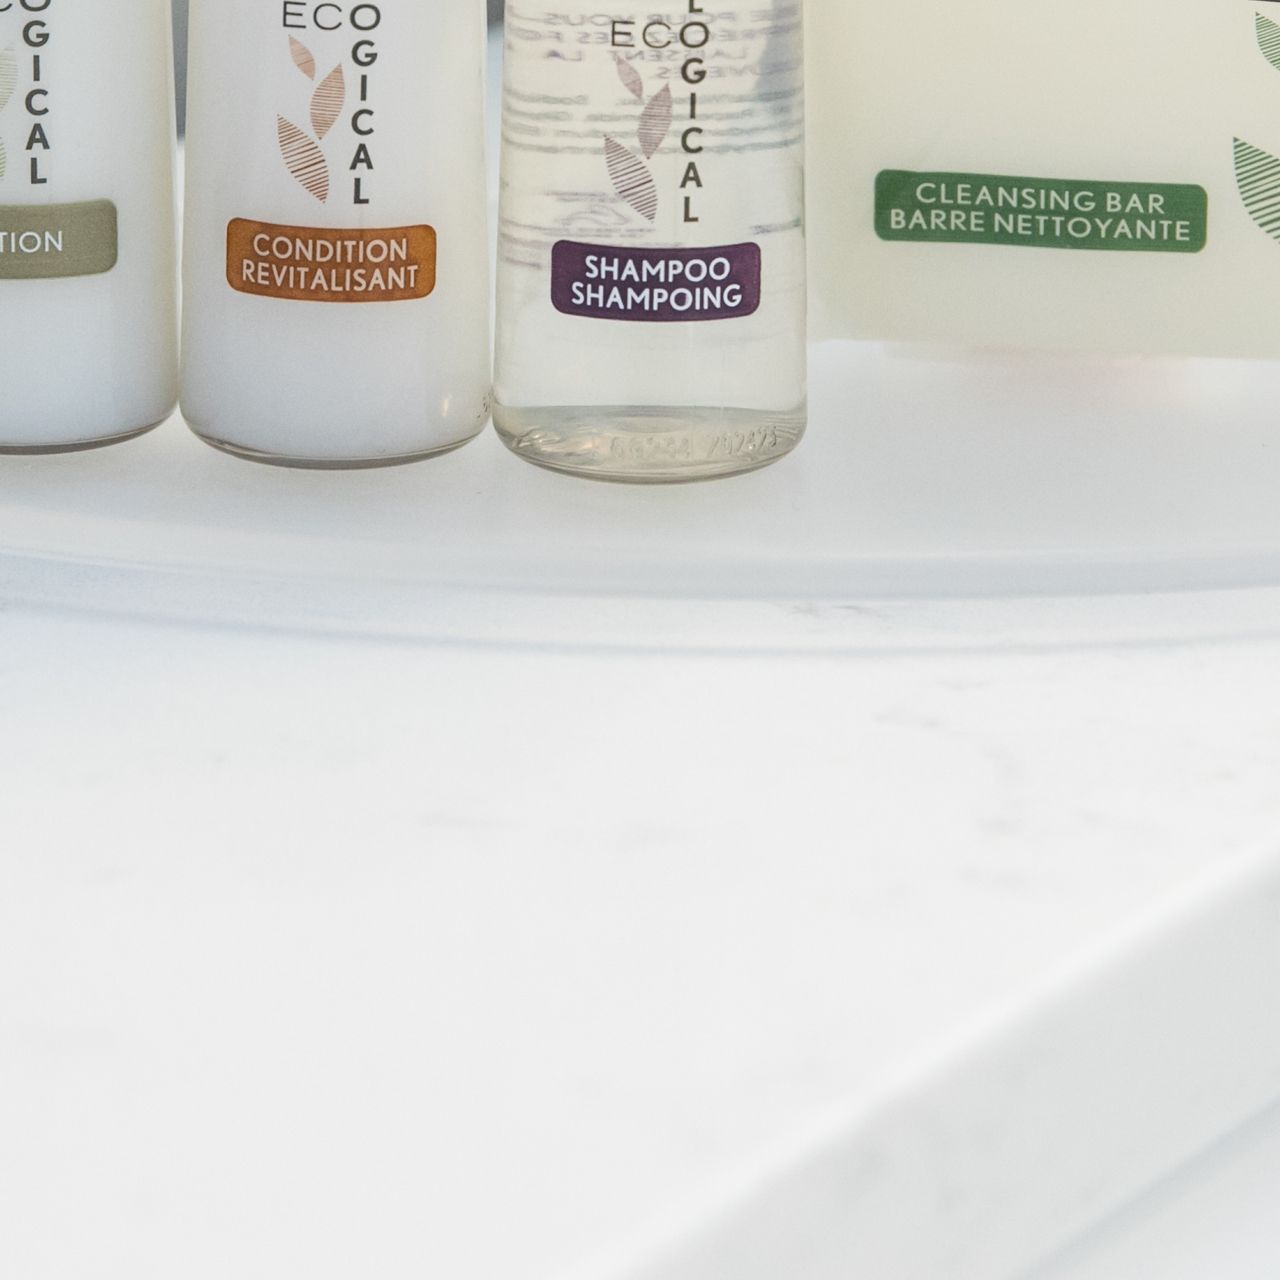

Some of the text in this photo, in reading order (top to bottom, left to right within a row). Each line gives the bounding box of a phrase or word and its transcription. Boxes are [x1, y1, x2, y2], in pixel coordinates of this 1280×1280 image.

[282, 1, 381, 31] ECO
[611, 20, 709, 49] ECO
[915, 181, 1165, 214] CLEANSING BAR
[891, 209, 1191, 241] BARRE NETTOYANTE
[253, 233, 407, 263] CONDITION
[241, 258, 419, 293] REVITALISANT
[585, 255, 731, 282] SHAMPOO
[572, 282, 742, 311] SHAMPOING
